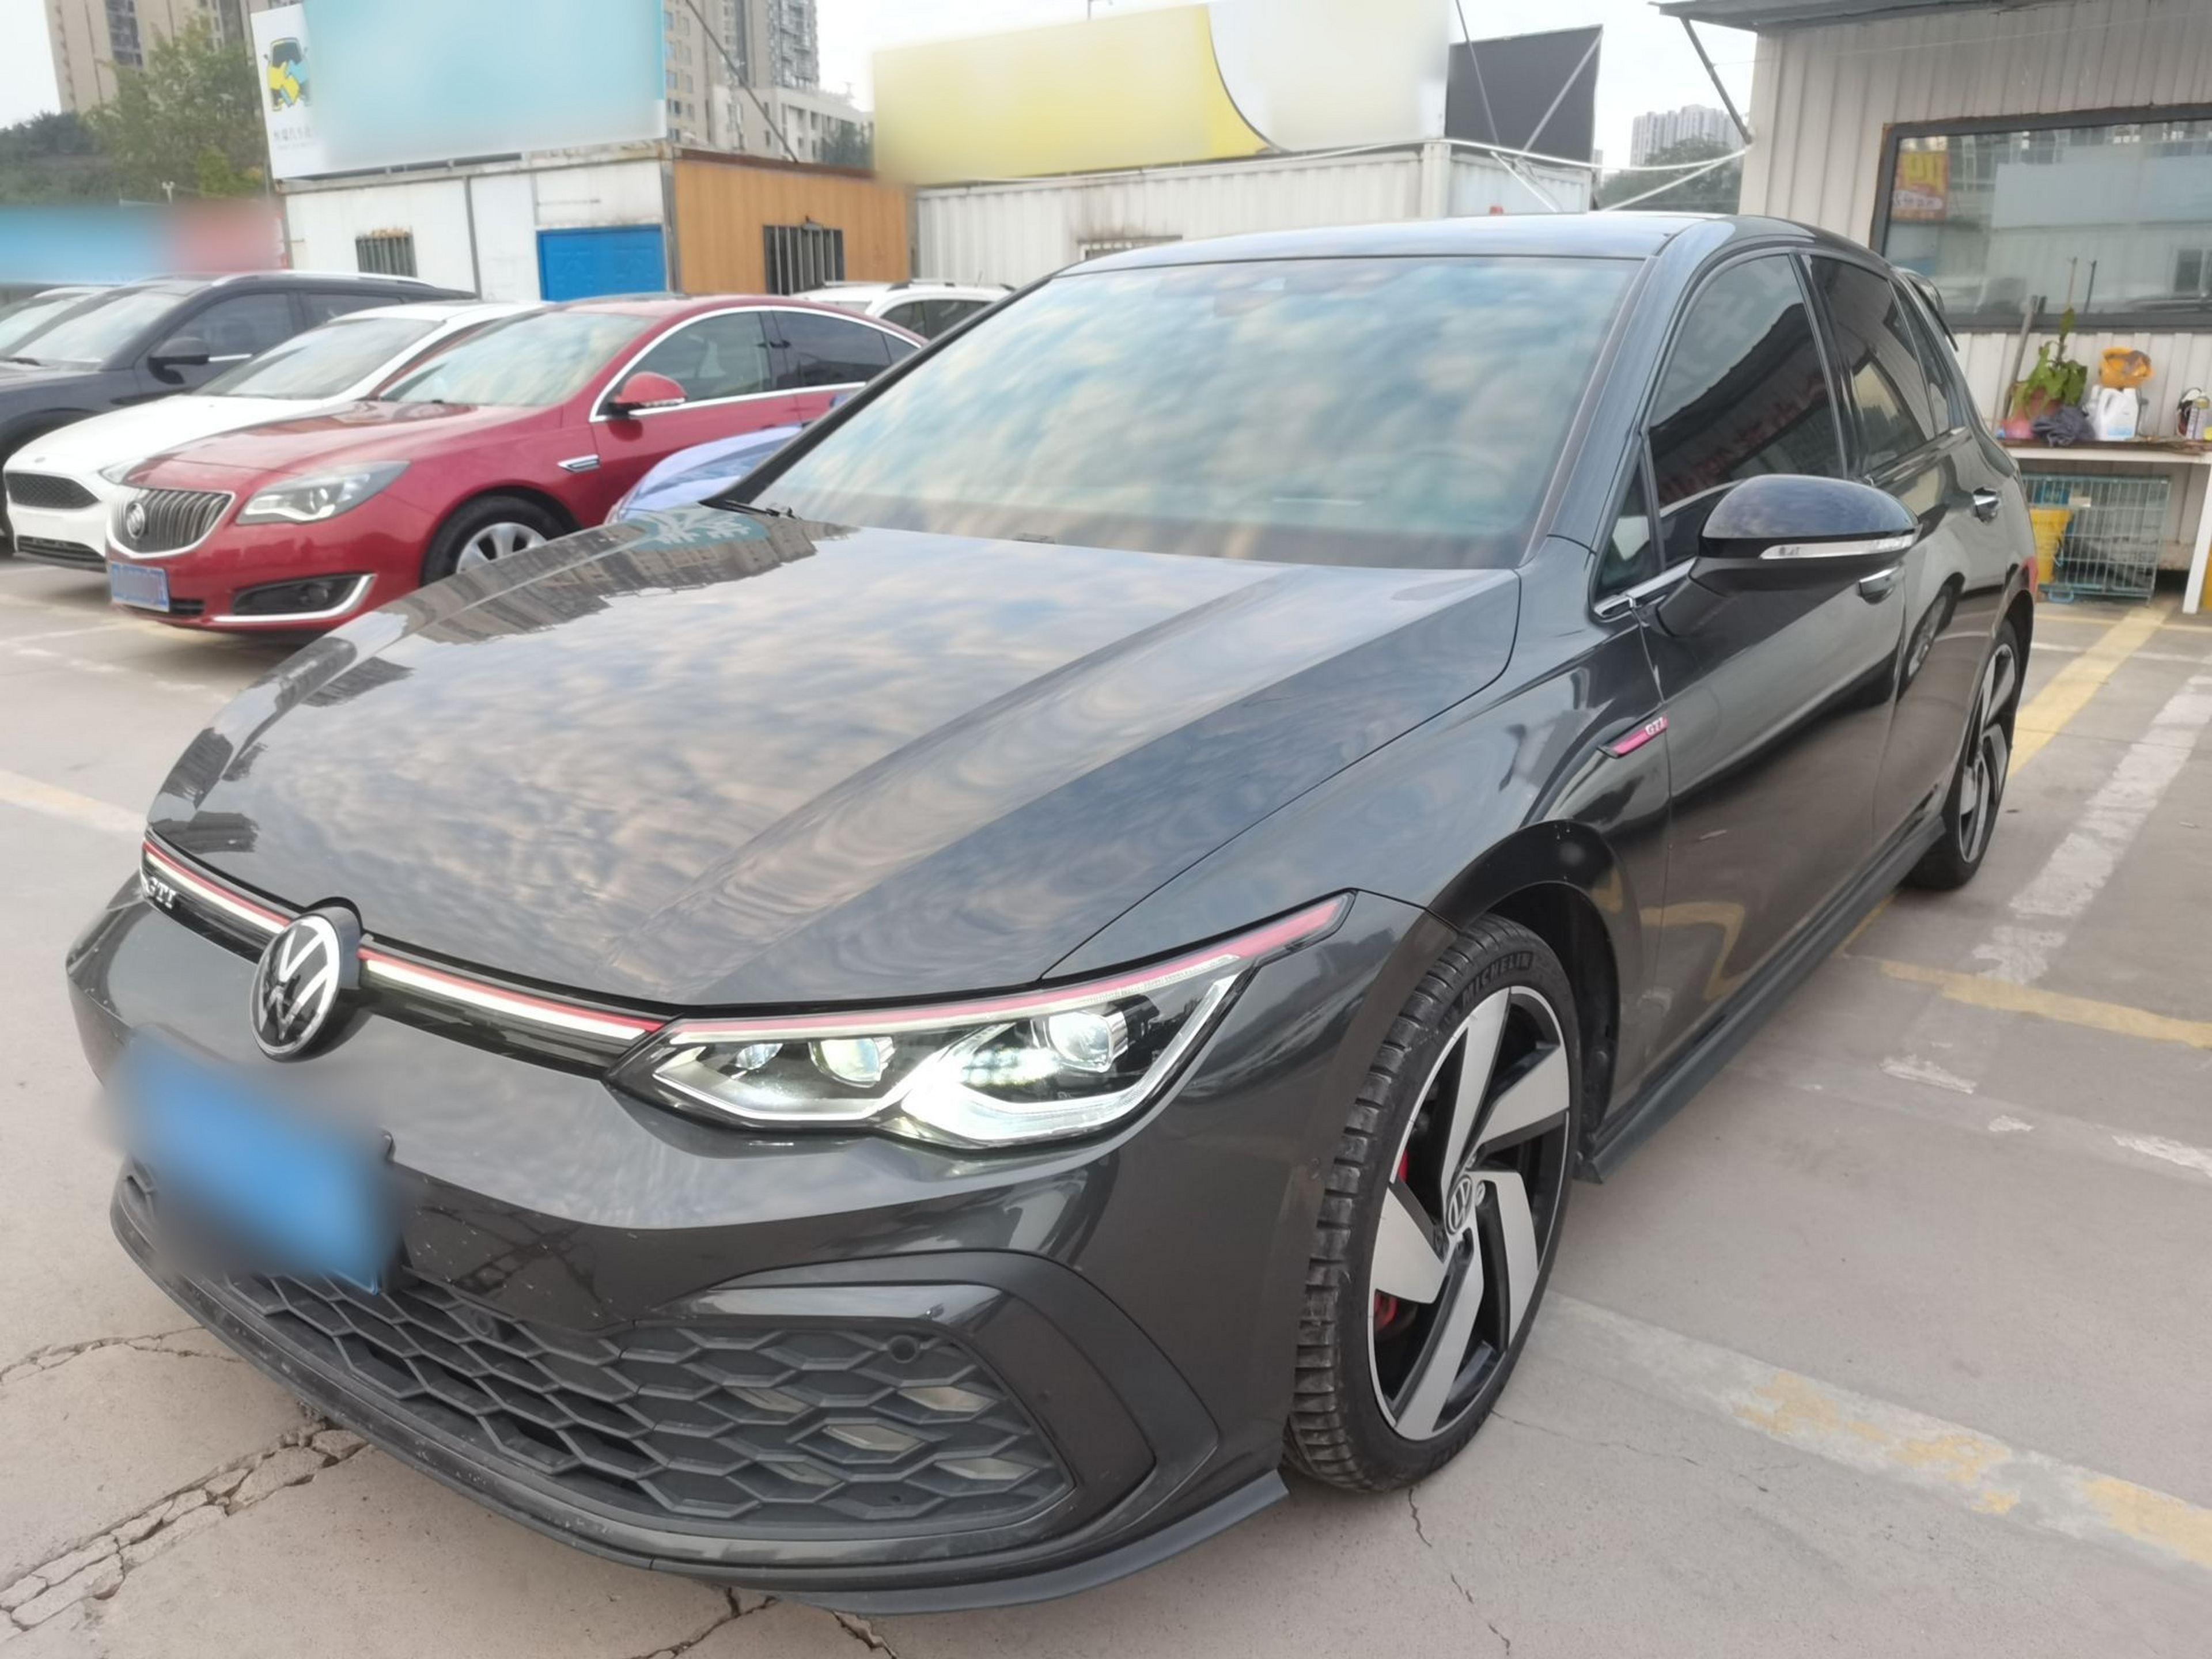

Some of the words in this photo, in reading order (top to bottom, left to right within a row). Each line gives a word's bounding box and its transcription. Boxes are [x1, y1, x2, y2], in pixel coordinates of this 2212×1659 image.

[1645, 717, 1664, 736] GTI
[145, 876, 176, 909] GTI
[1461, 952, 1531, 1008] MICHELIN
